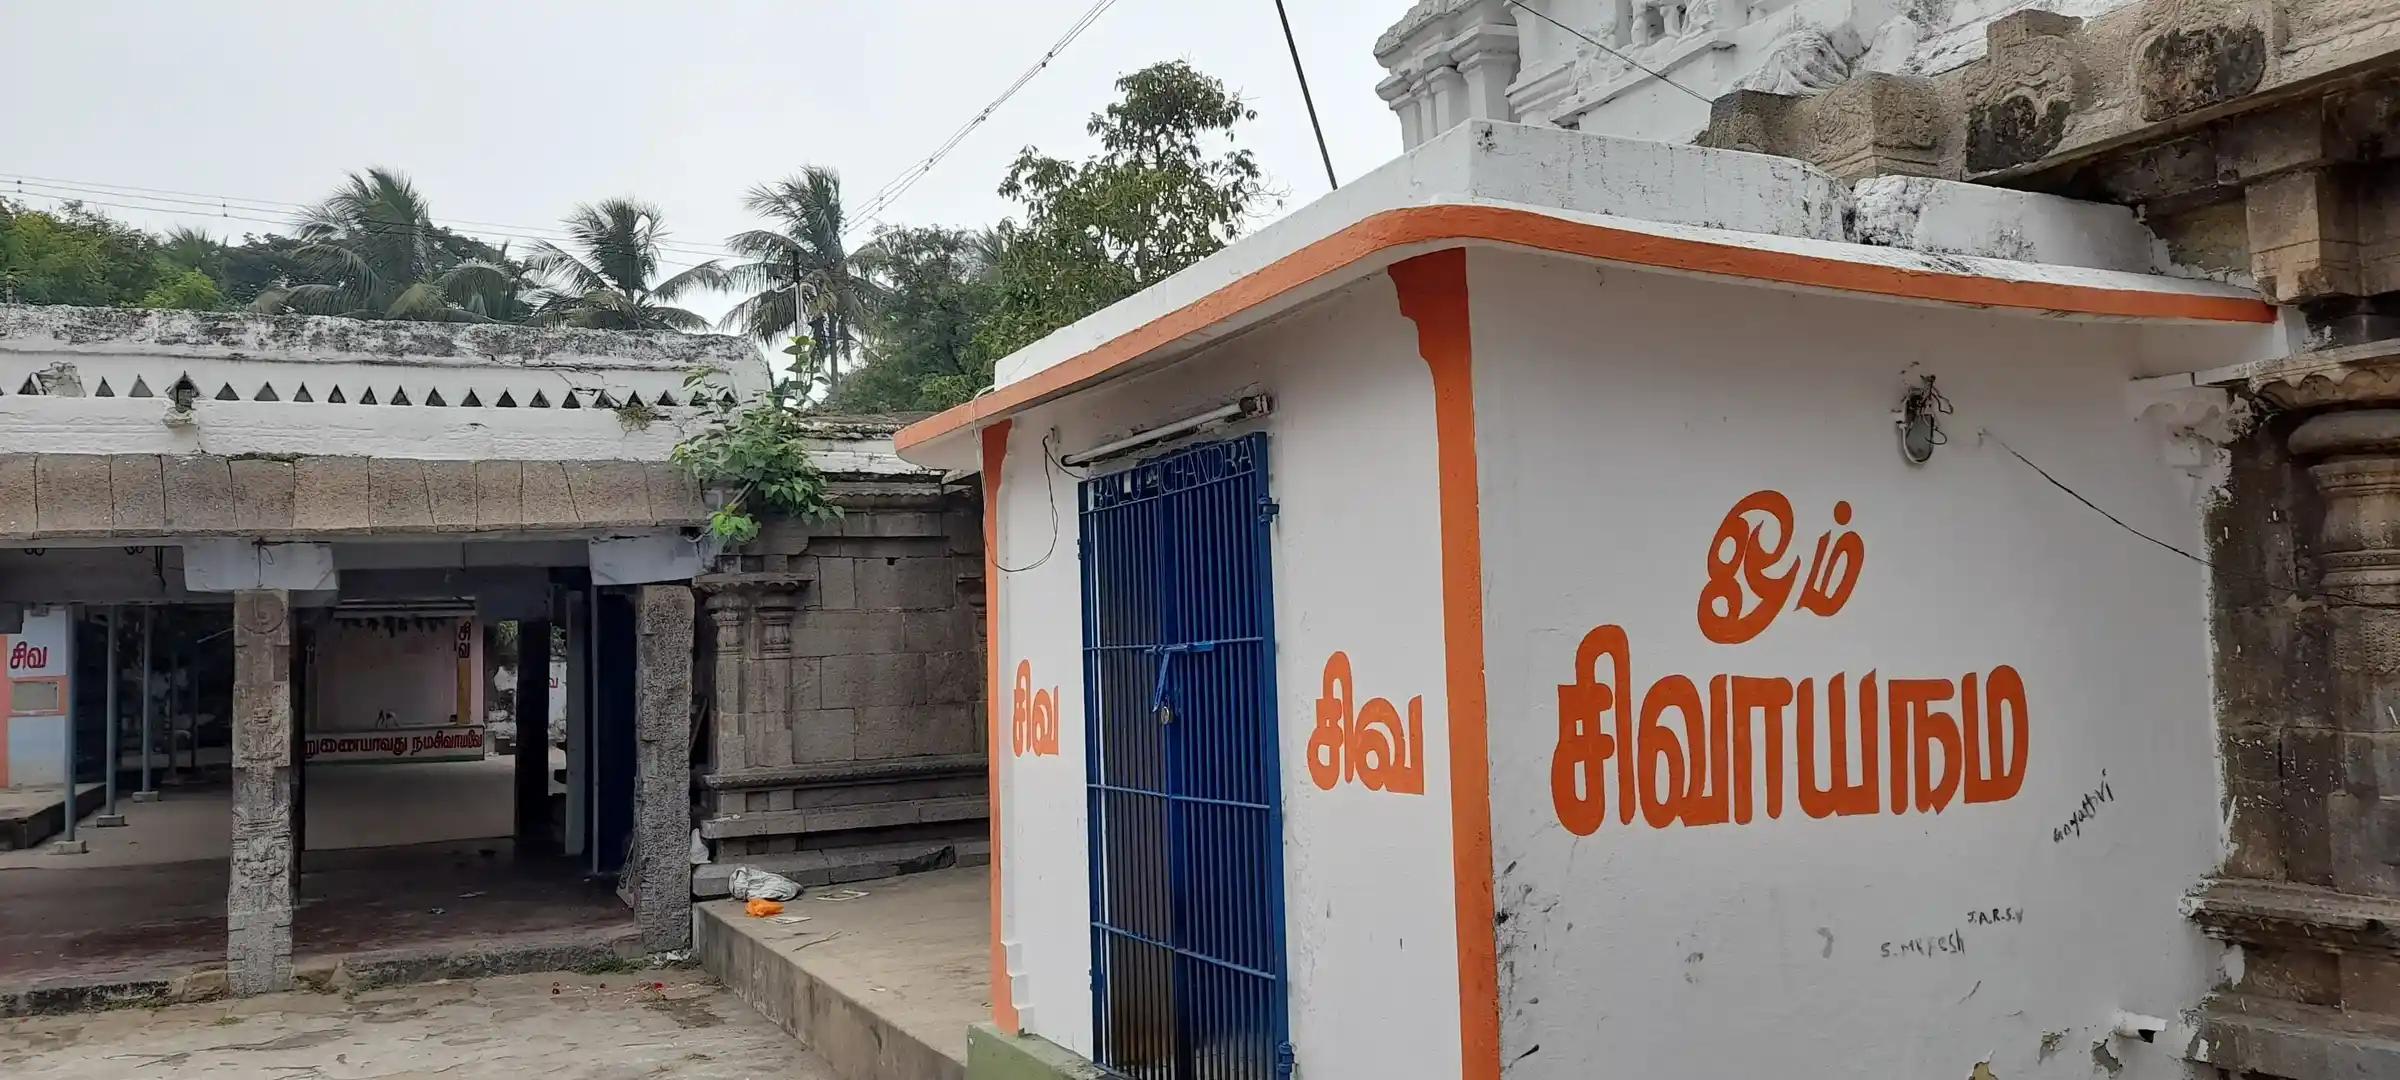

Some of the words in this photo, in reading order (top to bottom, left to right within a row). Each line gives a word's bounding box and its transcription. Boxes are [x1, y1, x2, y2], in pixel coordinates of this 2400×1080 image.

[1160, 436, 1256, 494] CHANDRA
[1697, 489, 1866, 645] ஓம்
[9, 641, 48, 670] சிவ
[1012, 659, 1060, 758] சிவ
[1306, 651, 1425, 796] சிவ
[1551, 624, 2030, 837] சிவாயநம
